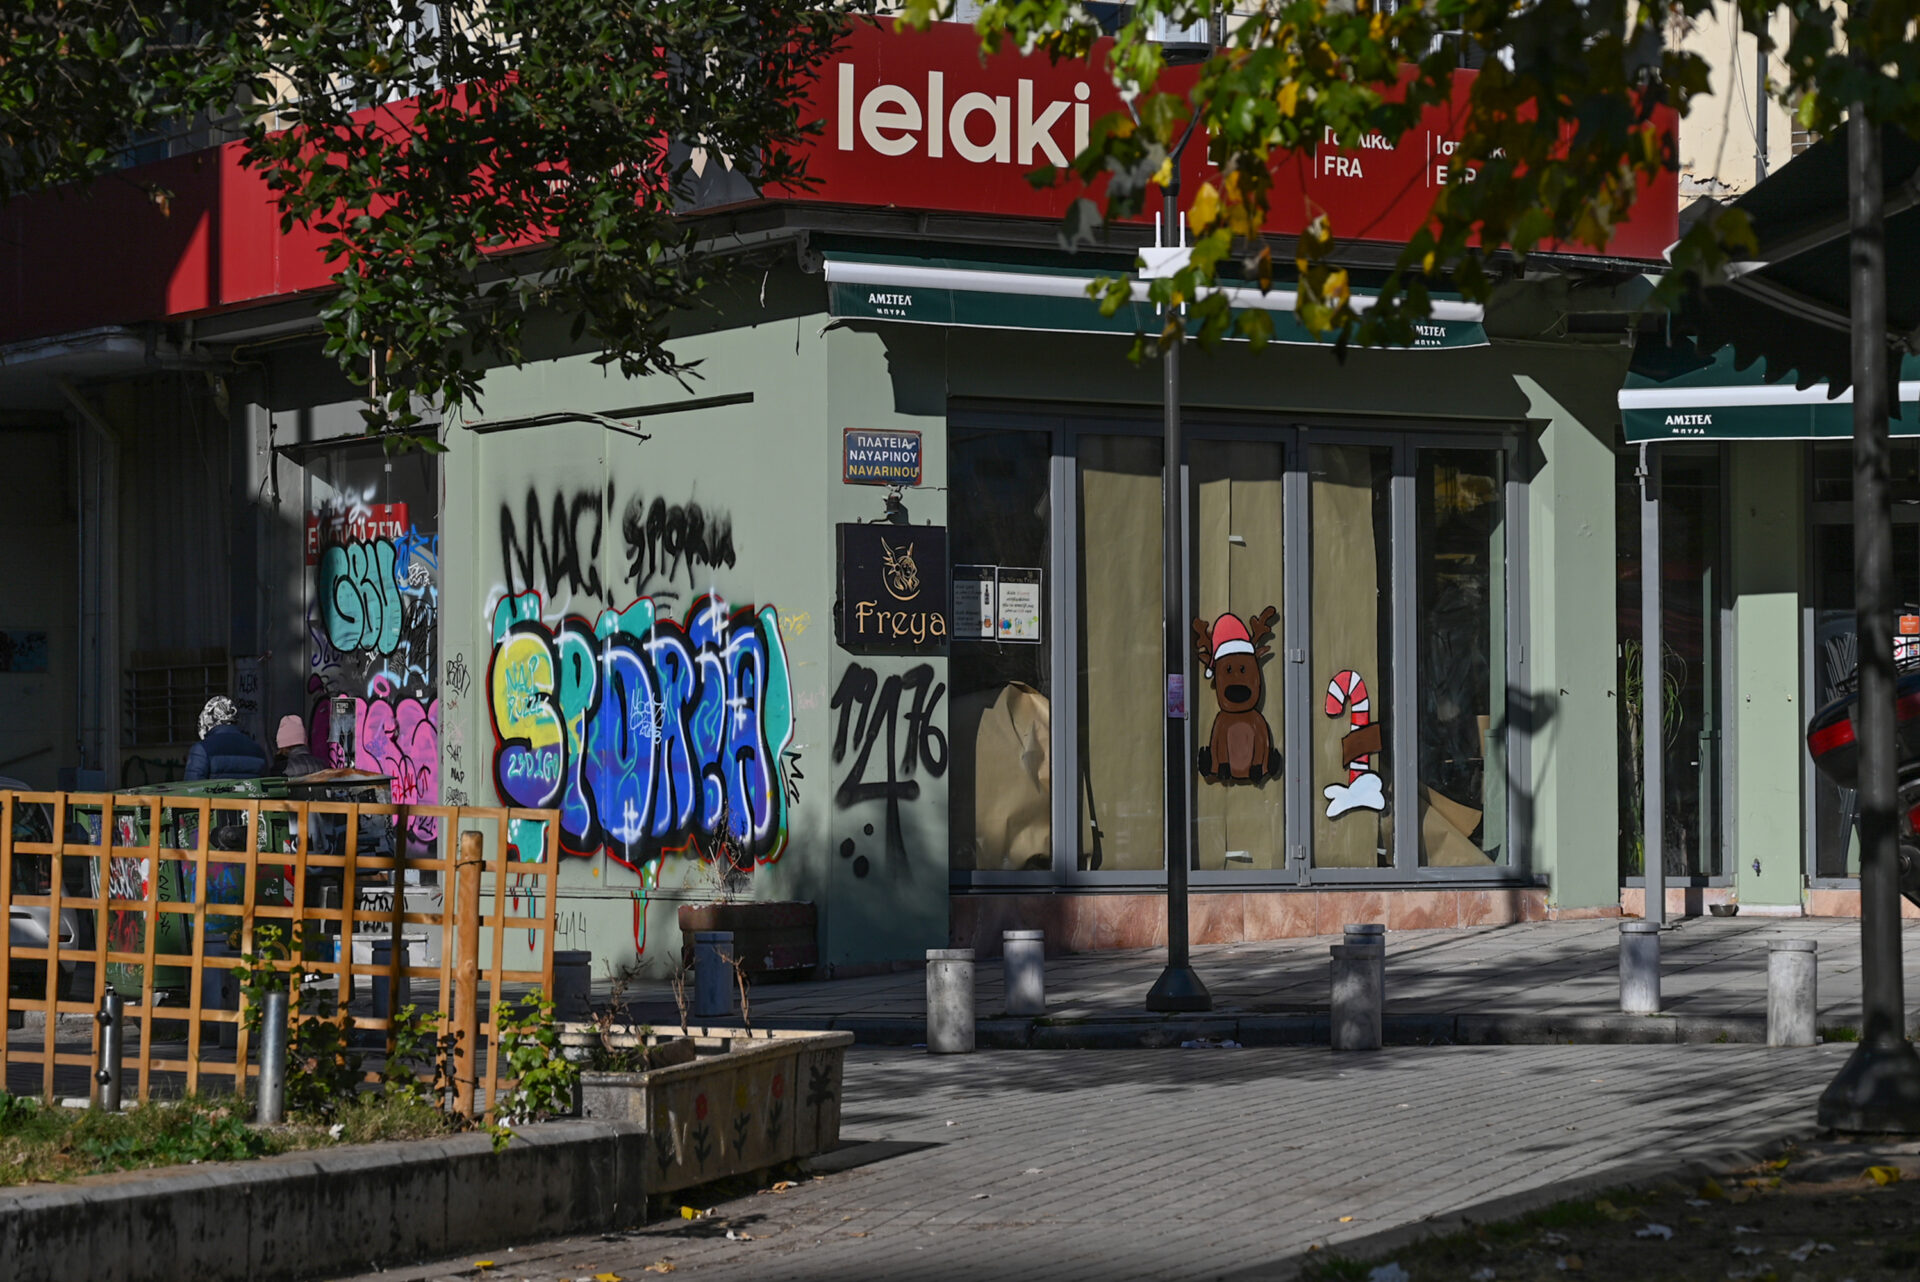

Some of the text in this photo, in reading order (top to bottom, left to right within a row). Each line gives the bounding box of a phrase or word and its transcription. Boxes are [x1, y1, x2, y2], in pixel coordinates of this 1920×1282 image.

[838, 62, 1091, 168] lelaki
[1324, 155, 1363, 178] FRA
[1436, 165, 1477, 185] EP
[868, 292, 912, 306] ΑΜΣΤΕΛ
[876, 308, 906, 316] ΜΠΥΡΑ
[1410, 324, 1446, 337] ΜΣΤΕΛ
[1665, 414, 1712, 425] ΑΜΣΤΕΛ
[857, 436, 909, 449] ΠΛΑΤΕΙΑ
[849, 449, 917, 463] ΝΑΥΑΡΙΝΟΥ
[849, 464, 918, 478] NAVARINOU
[855, 600, 946, 644] Freya
